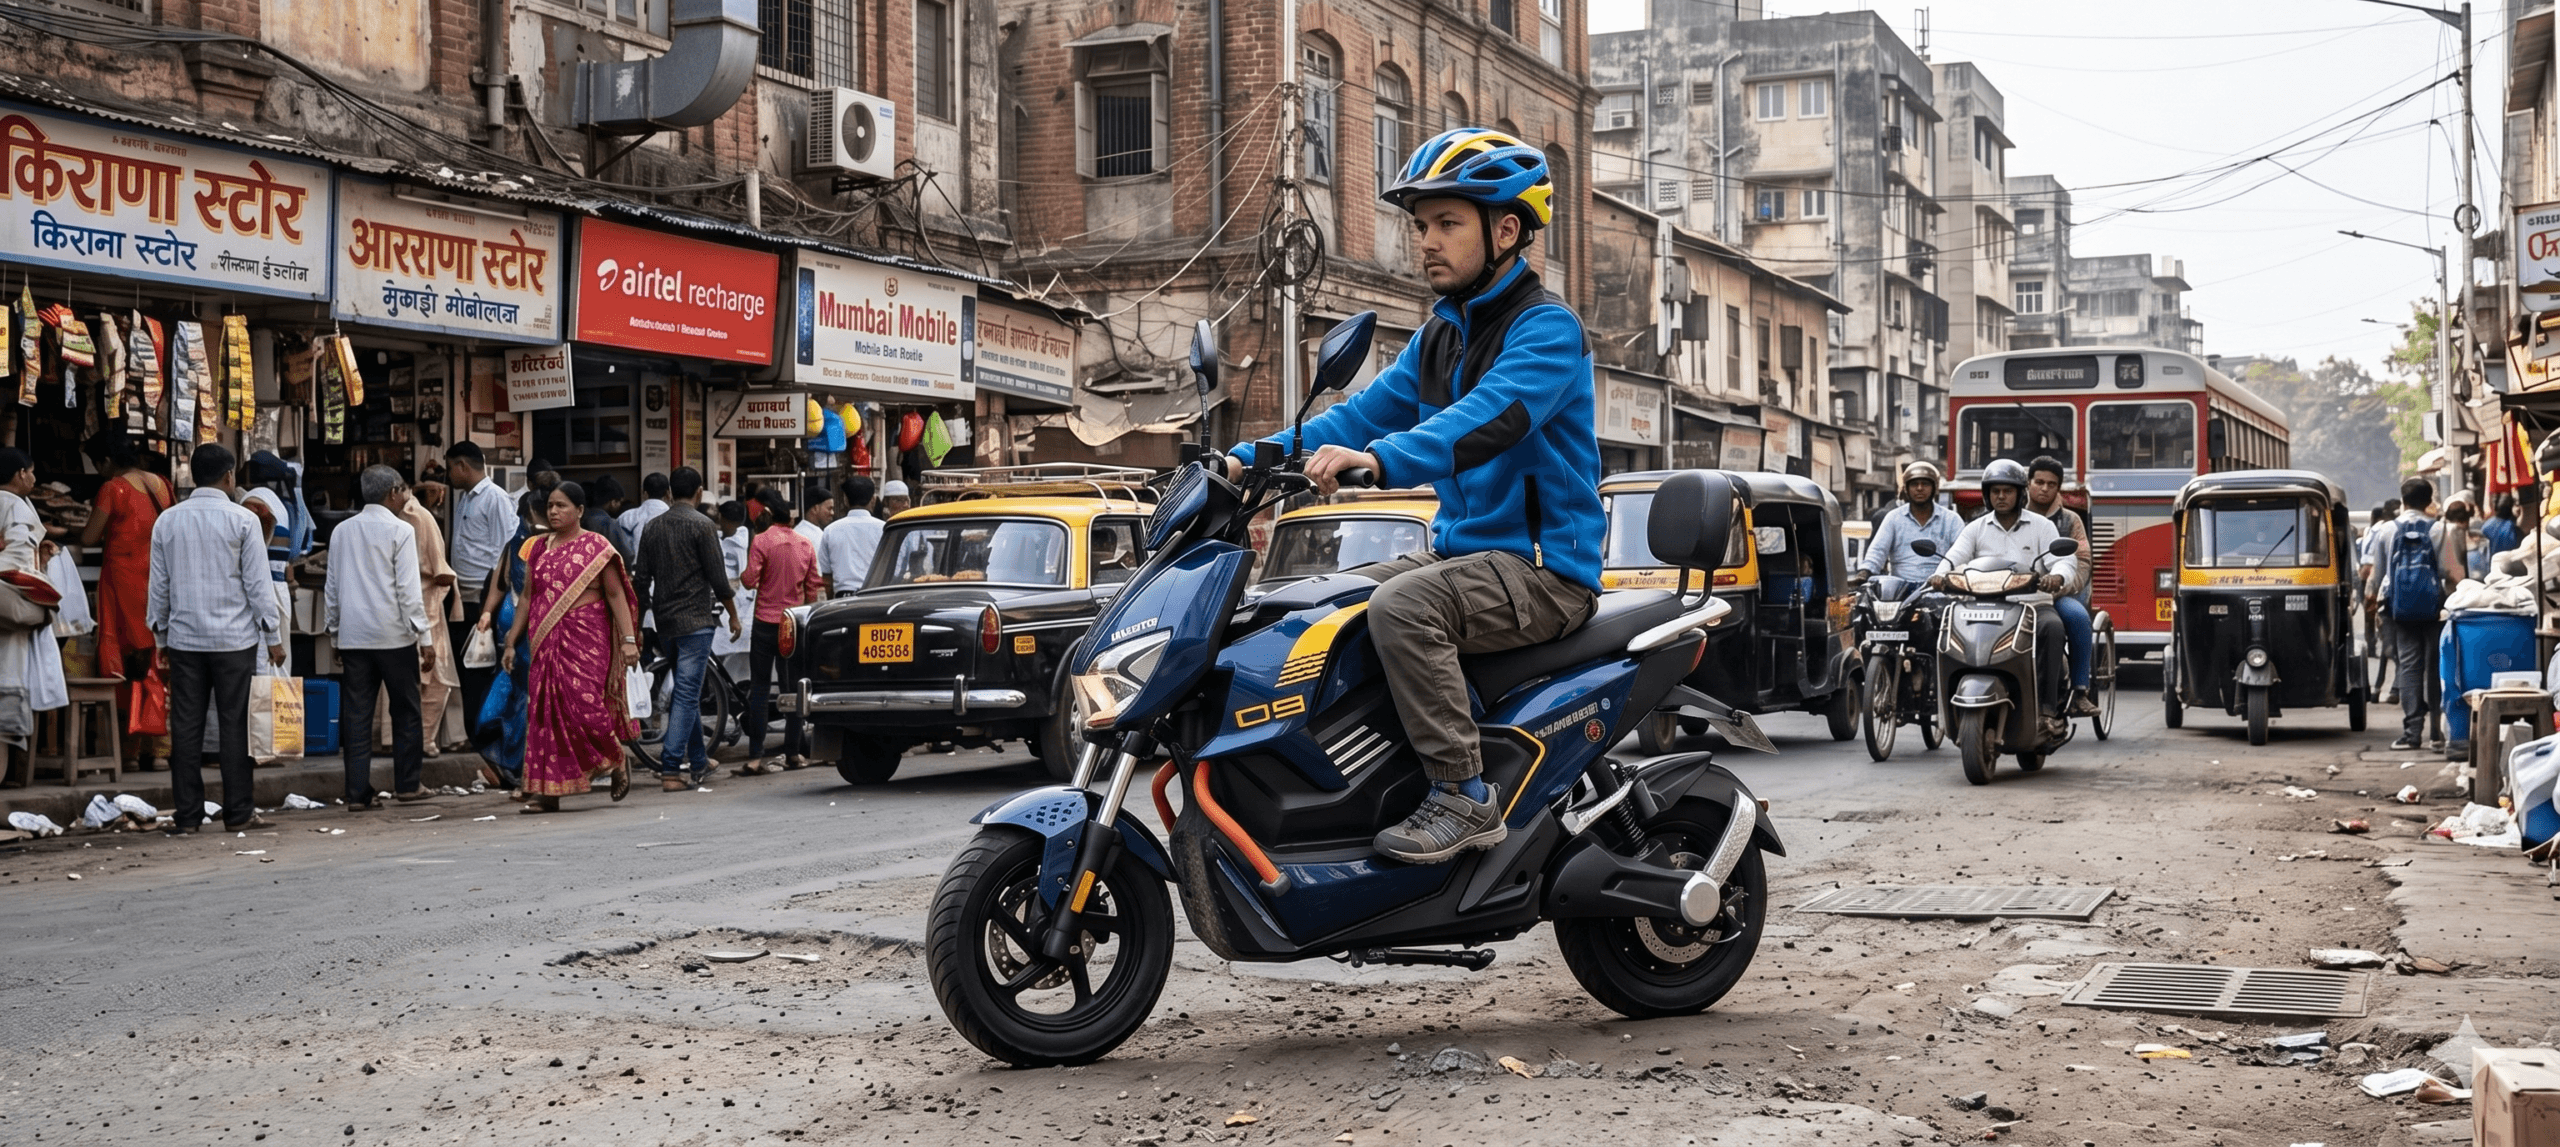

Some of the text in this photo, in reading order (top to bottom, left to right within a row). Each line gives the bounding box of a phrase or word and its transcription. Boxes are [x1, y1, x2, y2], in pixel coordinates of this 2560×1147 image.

[194, 159, 308, 244] स्टोर
[31, 210, 198, 271] किराना स्टोर
[482, 228, 549, 296] स्टोर
[622, 261, 765, 321] airtel recharge
[819, 291, 893, 336] Mumbai
[899, 304, 957, 346] Mobile
[1234, 694, 1306, 729] 09
